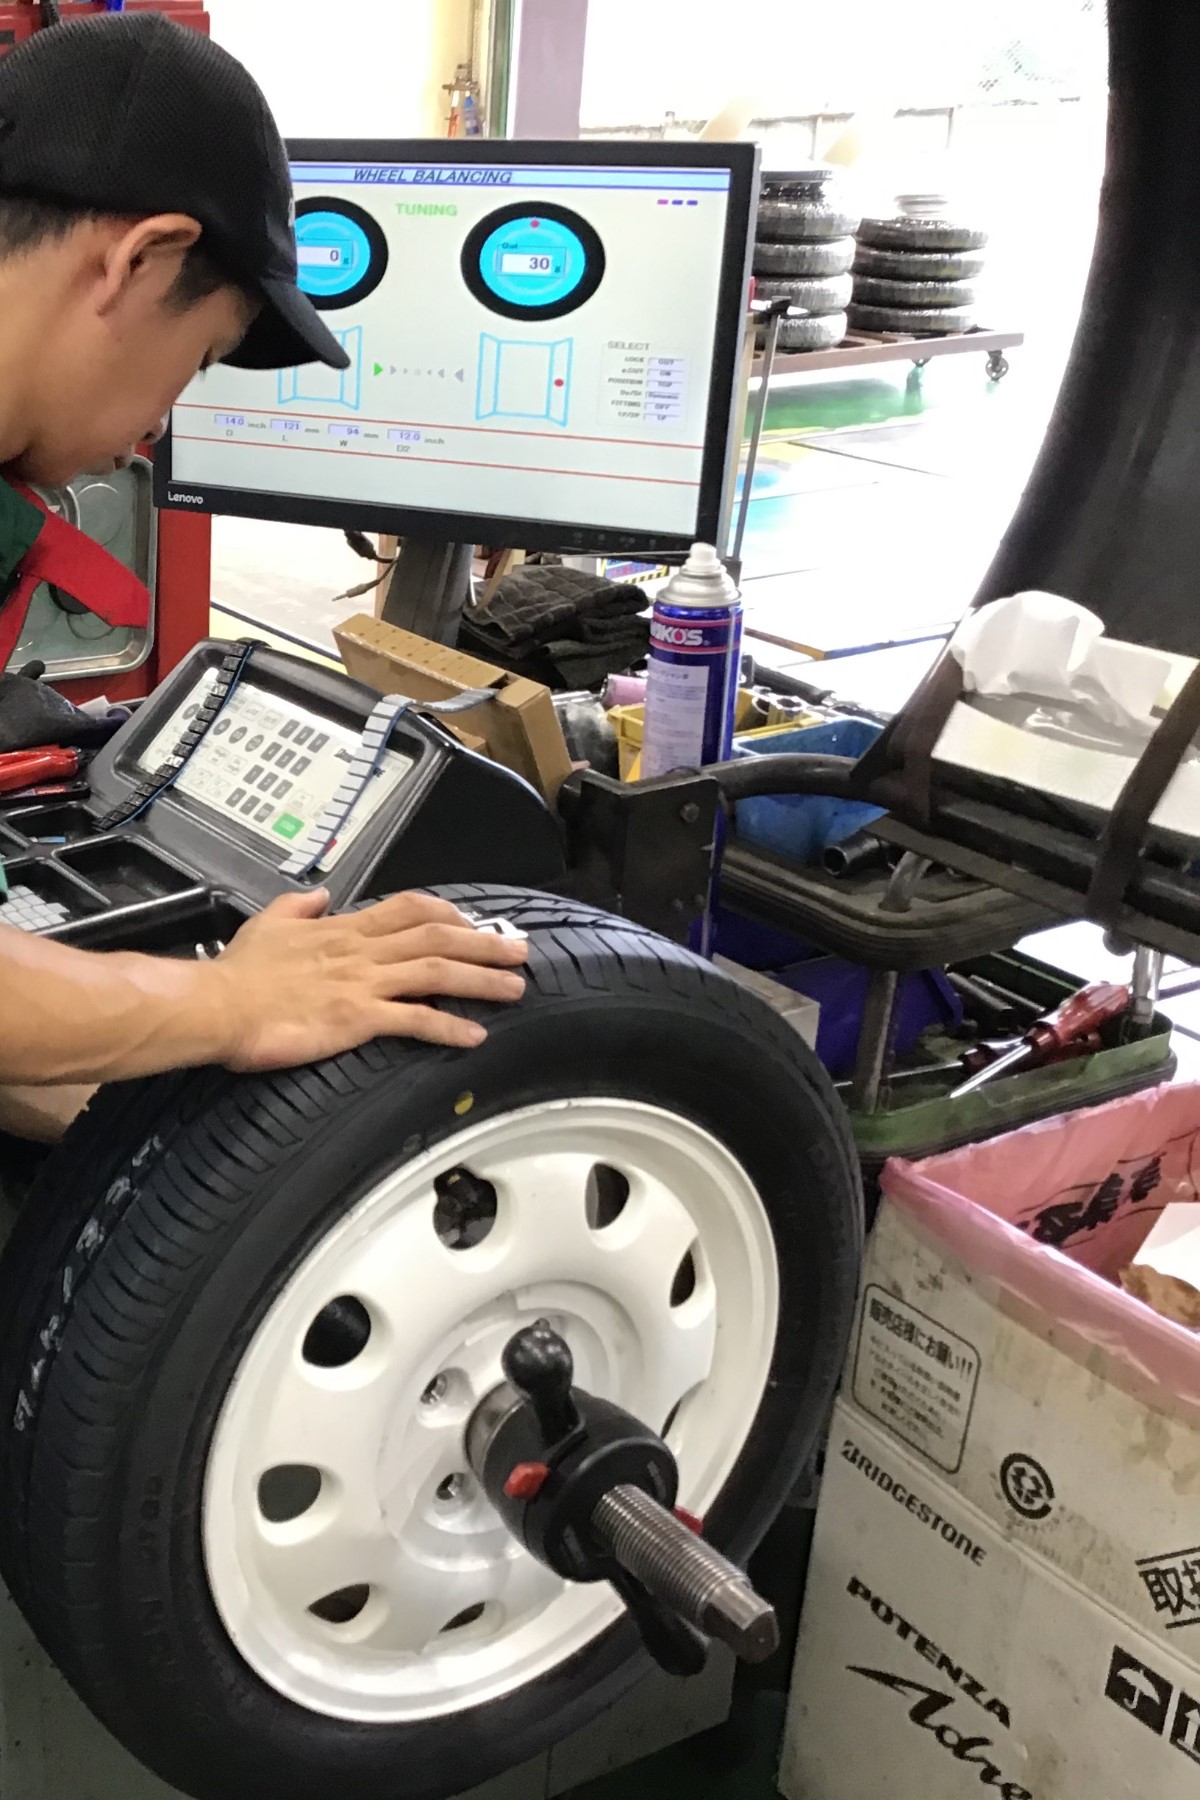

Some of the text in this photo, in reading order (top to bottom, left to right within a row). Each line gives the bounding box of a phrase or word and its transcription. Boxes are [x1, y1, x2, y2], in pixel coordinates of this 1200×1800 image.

[354, 169, 513, 185] WHEEL BALANCING
[396, 203, 458, 216] TUNING
[330, 249, 339, 262] 0
[529, 256, 550, 270] 30
[607, 341, 650, 350] SELECT
[284, 422, 300, 431] 121
[340, 439, 348, 447] W
[167, 490, 204, 505] Lenovo
[841, 1440, 987, 1567] BRIDGESTONE
[846, 1575, 1010, 1729] POTENZA
